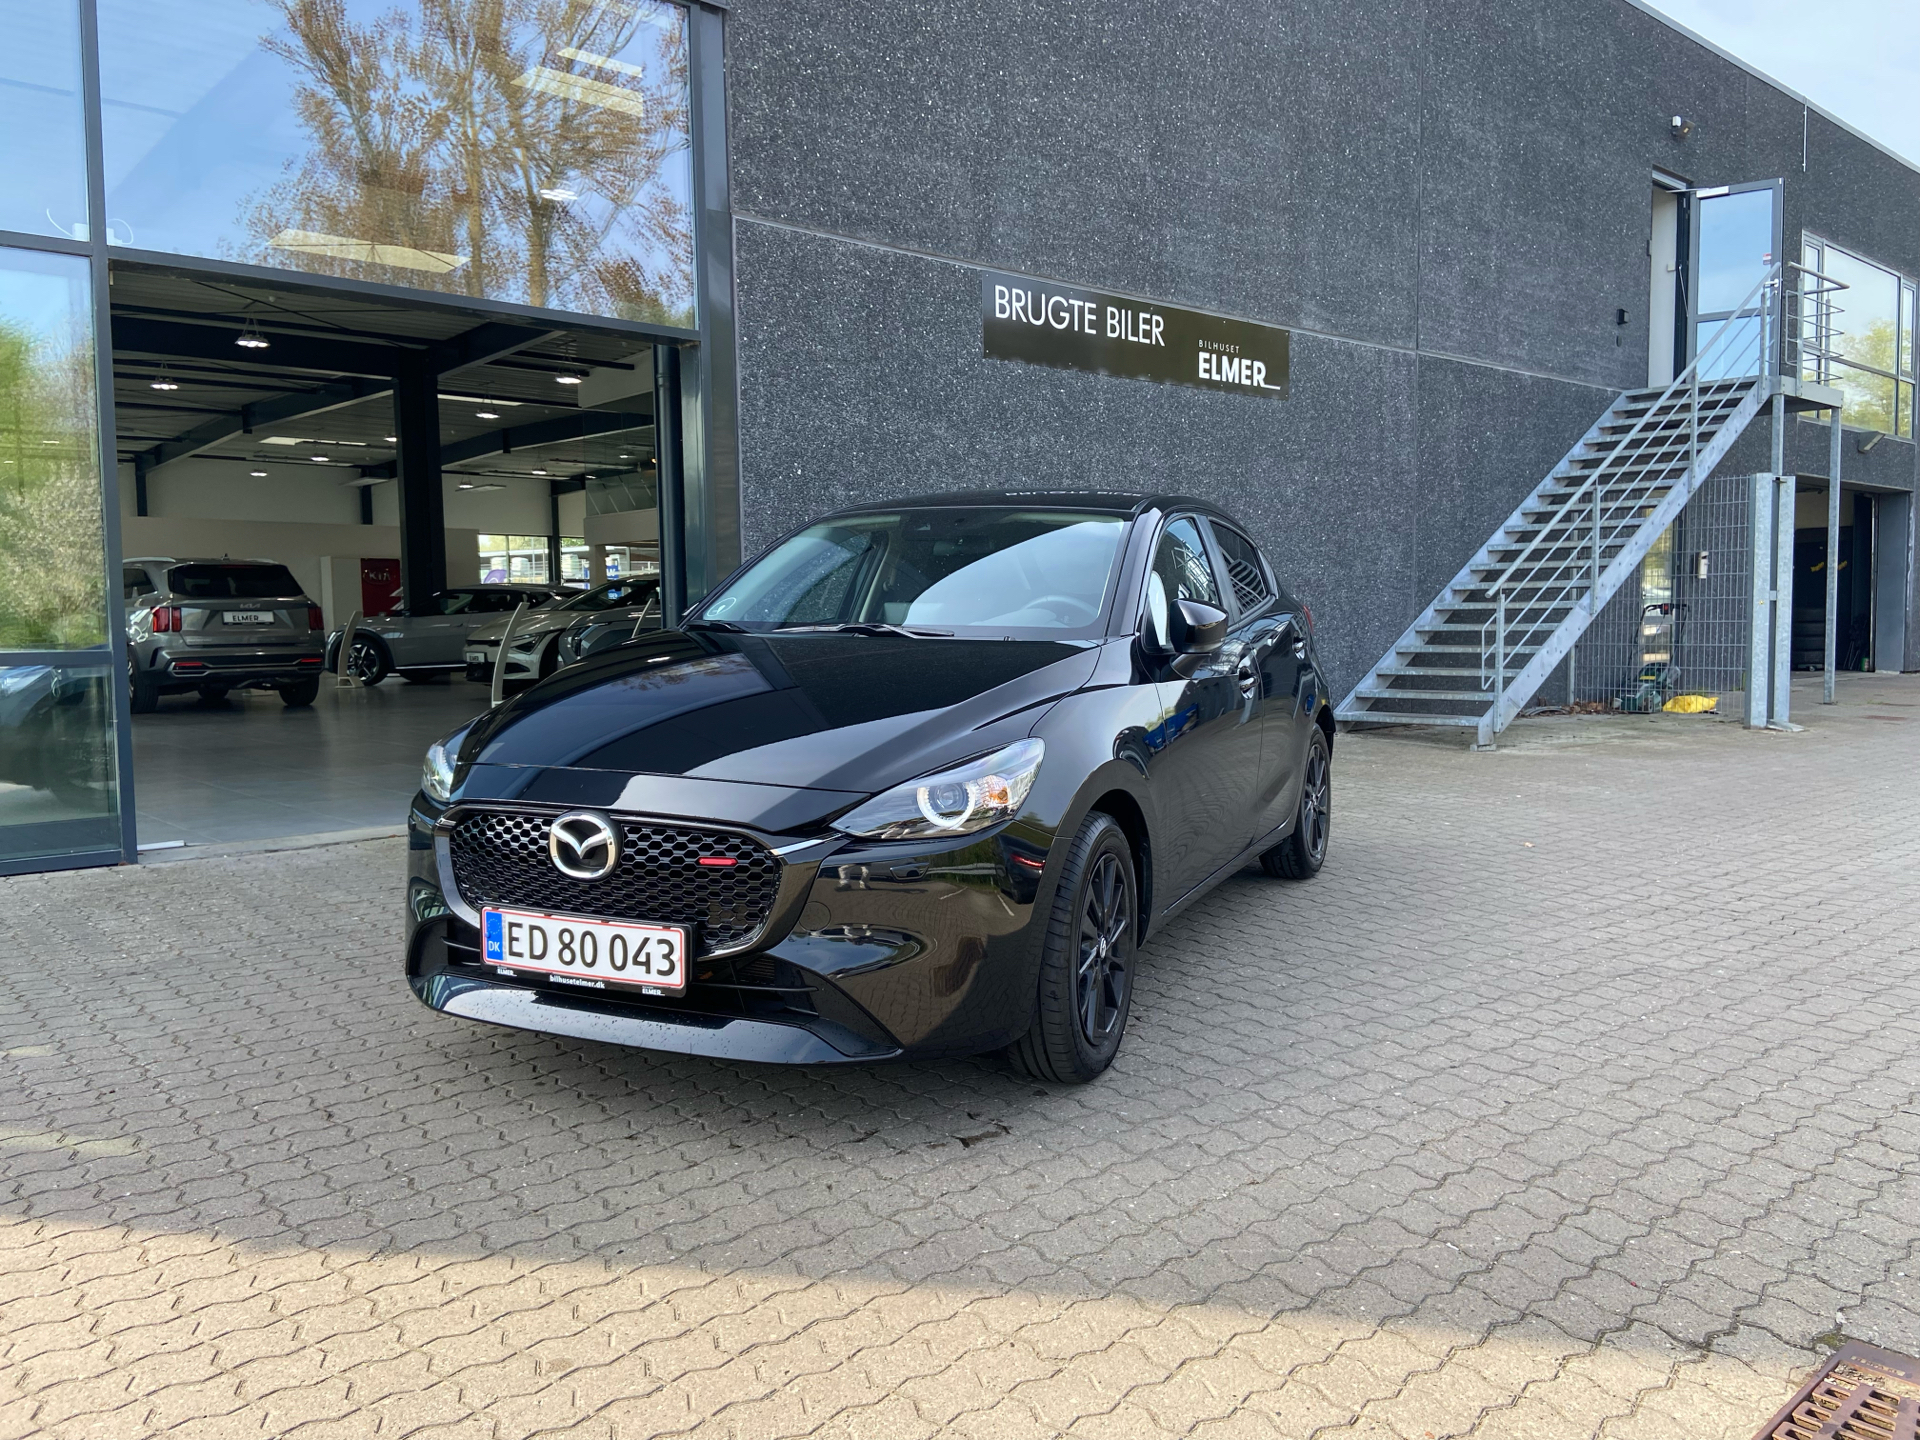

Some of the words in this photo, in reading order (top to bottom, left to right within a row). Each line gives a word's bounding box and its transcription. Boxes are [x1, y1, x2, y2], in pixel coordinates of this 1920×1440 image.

[994, 284, 1098, 335] BRUGTE
[1106, 306, 1166, 347] BILER
[1198, 339, 1240, 354] BILHUSET
[488, 940, 501, 953] DK
[508, 921, 548, 960] ED
[558, 927, 598, 969] 80
[608, 933, 676, 977] 043
[549, 974, 606, 989] bilhusetelmer.dk
